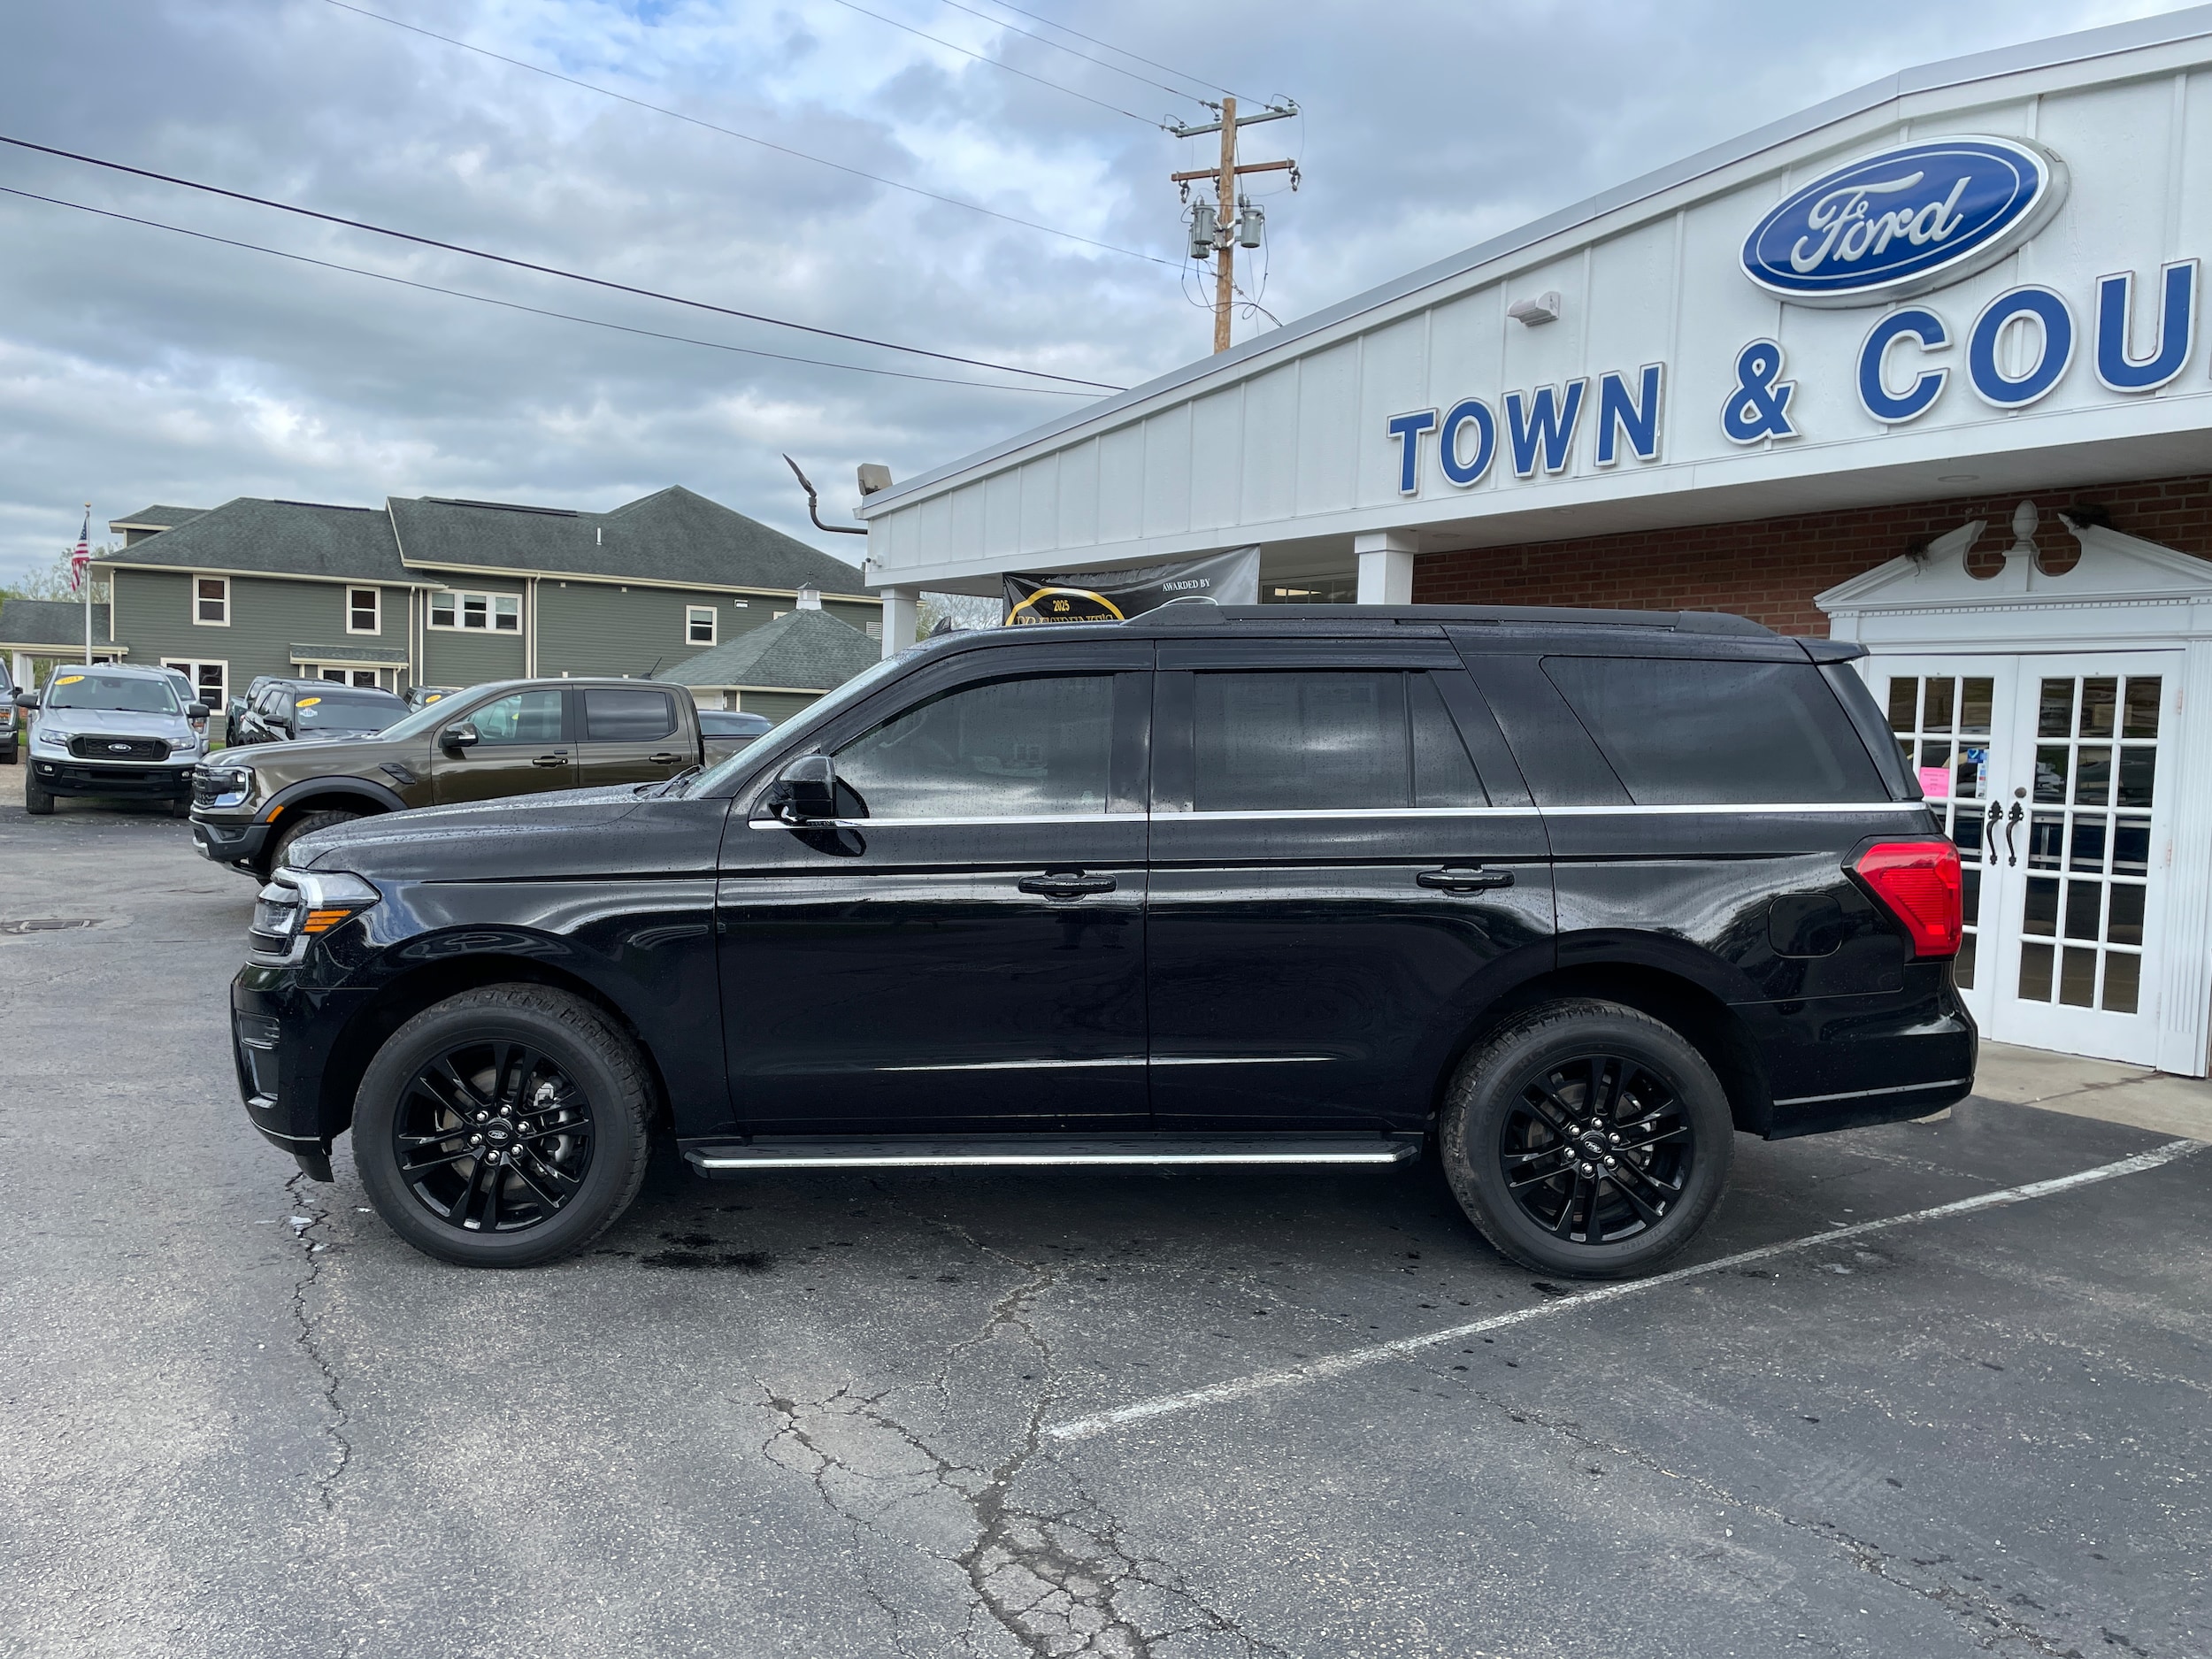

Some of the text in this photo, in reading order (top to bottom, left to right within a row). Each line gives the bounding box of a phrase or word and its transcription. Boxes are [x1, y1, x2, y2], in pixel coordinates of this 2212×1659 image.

[1791, 171, 1972, 274] Ford
[1387, 257, 2212, 496] TOWN & COU
[1052, 599, 1071, 613] 2025
[1162, 578, 1211, 592] AWARDED BY
